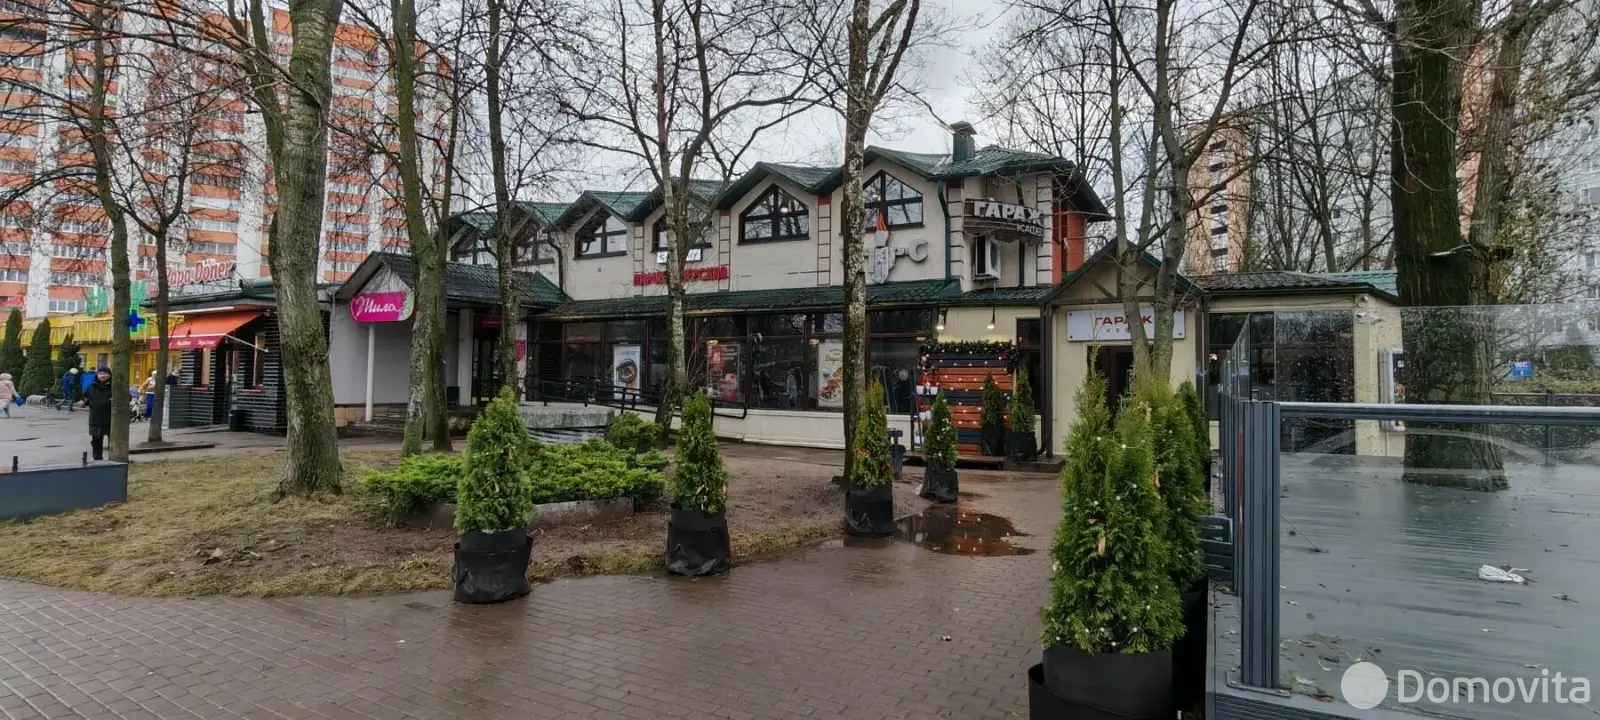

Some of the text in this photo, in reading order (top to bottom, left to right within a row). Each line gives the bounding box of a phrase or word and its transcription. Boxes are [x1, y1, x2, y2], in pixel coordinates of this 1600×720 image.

[973, 201, 1043, 225] ГАРАЖ
[195, 259, 236, 283] Döner
[356, 297, 397, 316] Мила
[1095, 315, 1152, 325] ГАРЖ
